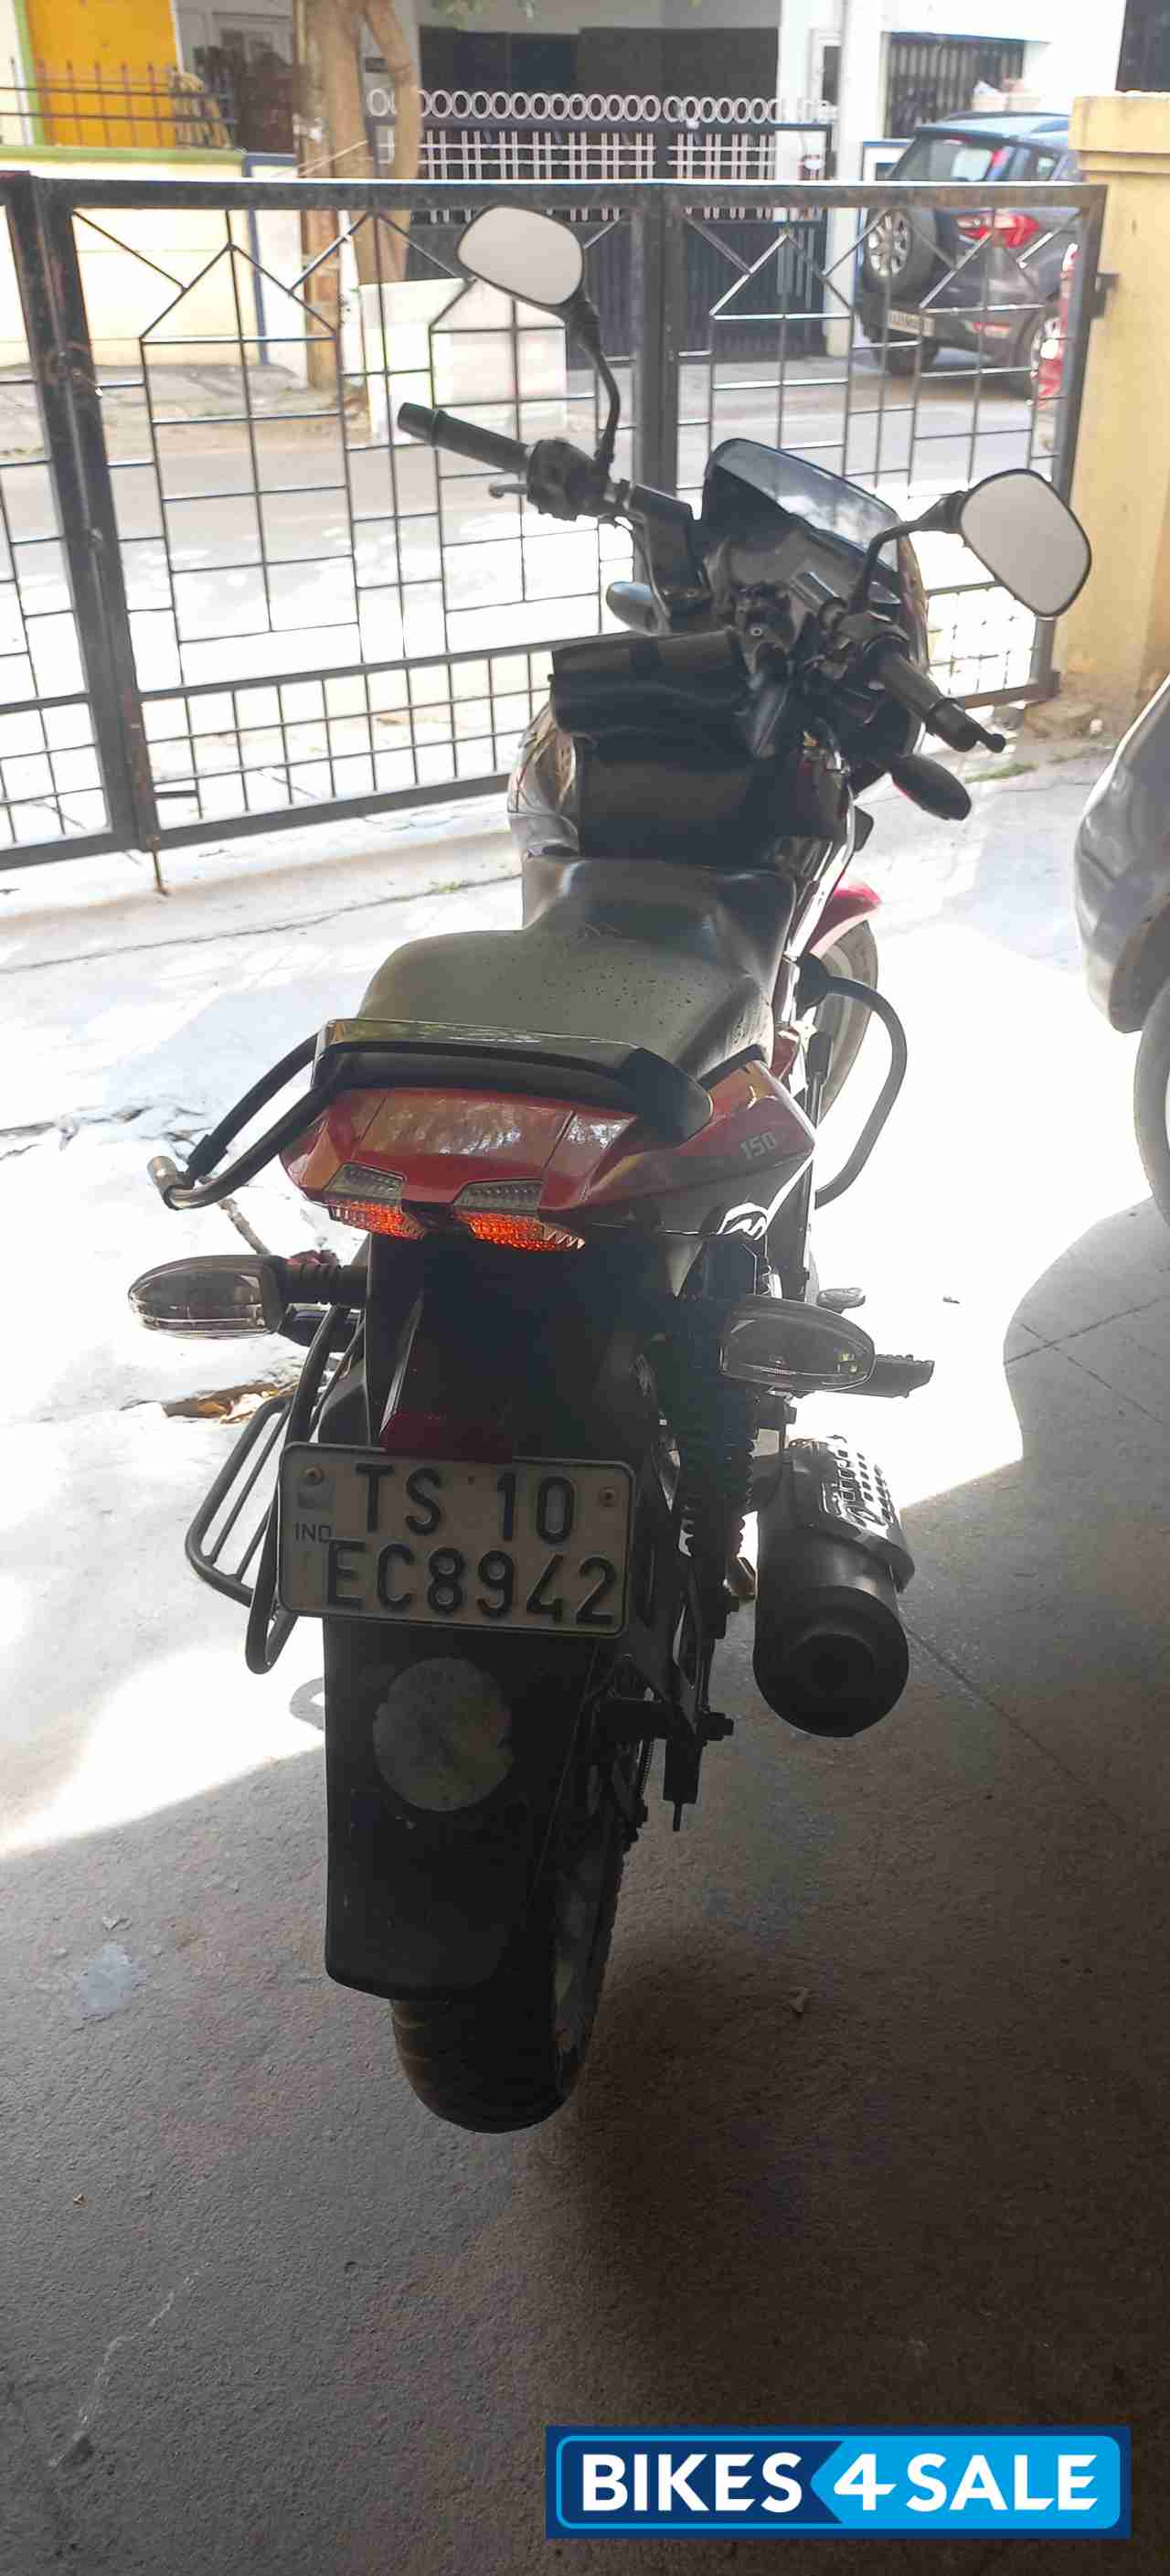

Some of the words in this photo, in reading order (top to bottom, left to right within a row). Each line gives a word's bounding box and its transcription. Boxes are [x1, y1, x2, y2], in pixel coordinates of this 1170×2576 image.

[739, 1131, 776, 1160] 150
[356, 1463, 442, 1535] TS
[496, 1471, 576, 1544] 10
[294, 1523, 333, 1544] IND
[325, 1538, 617, 1625] EC8942
